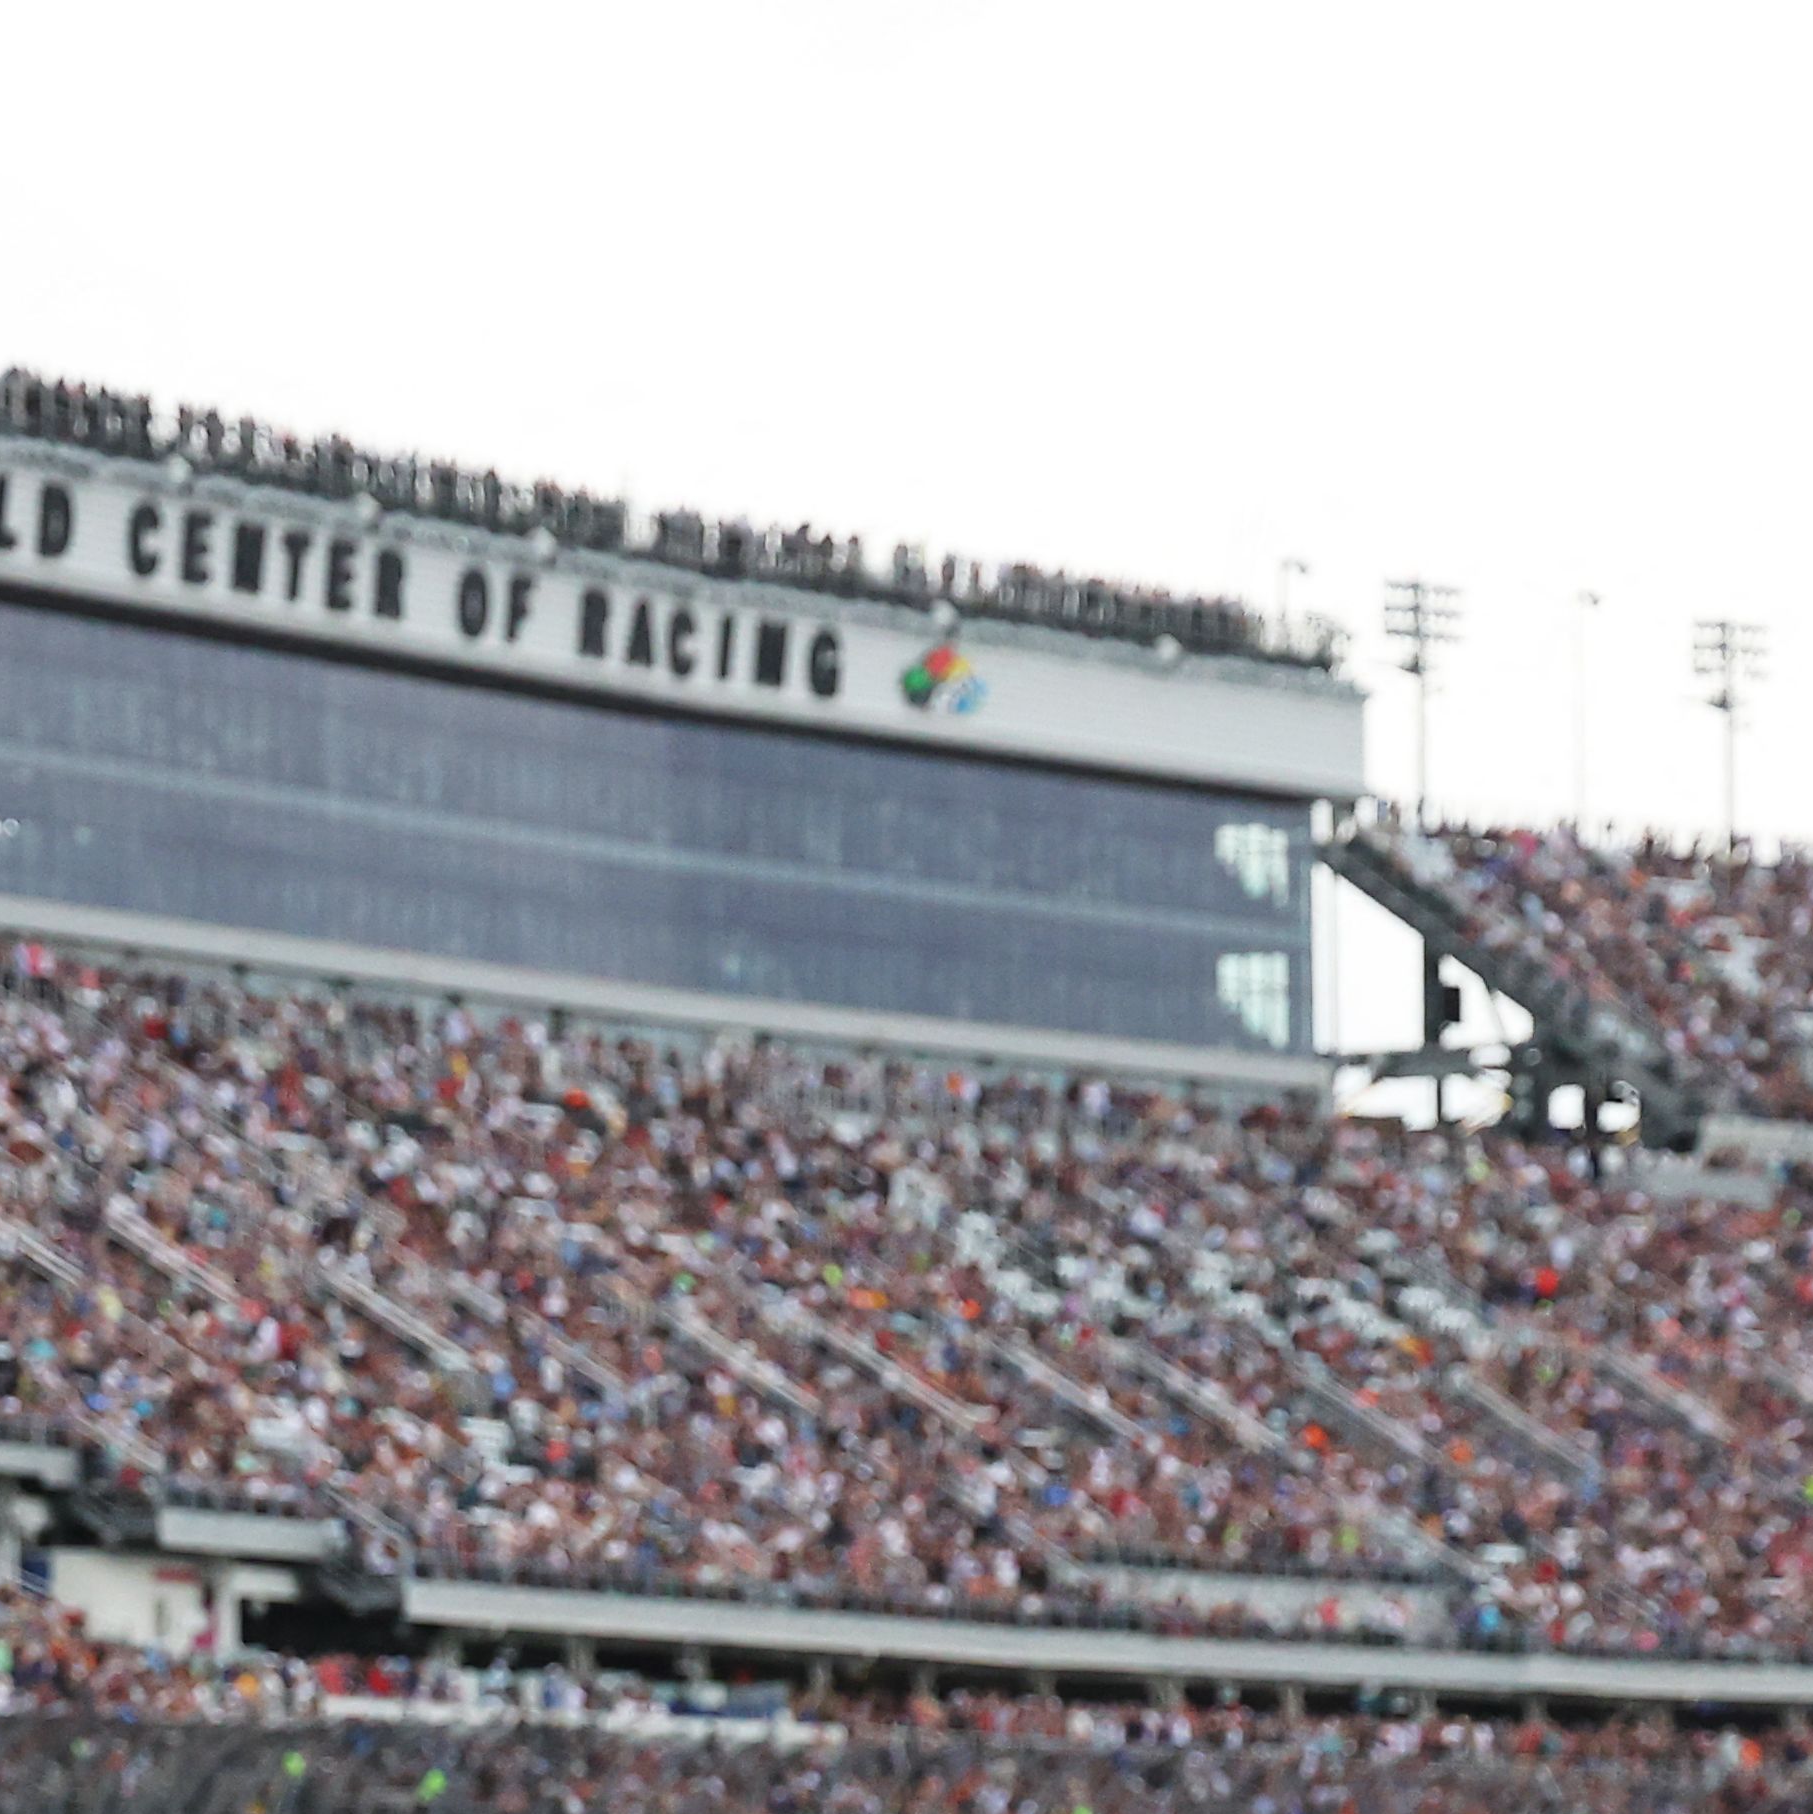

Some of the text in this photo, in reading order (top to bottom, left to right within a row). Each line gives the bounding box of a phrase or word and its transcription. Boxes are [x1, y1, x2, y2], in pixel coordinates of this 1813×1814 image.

[129, 503, 404, 620] CENTER
[458, 567, 534, 643] OF
[579, 589, 841, 697] RACING
